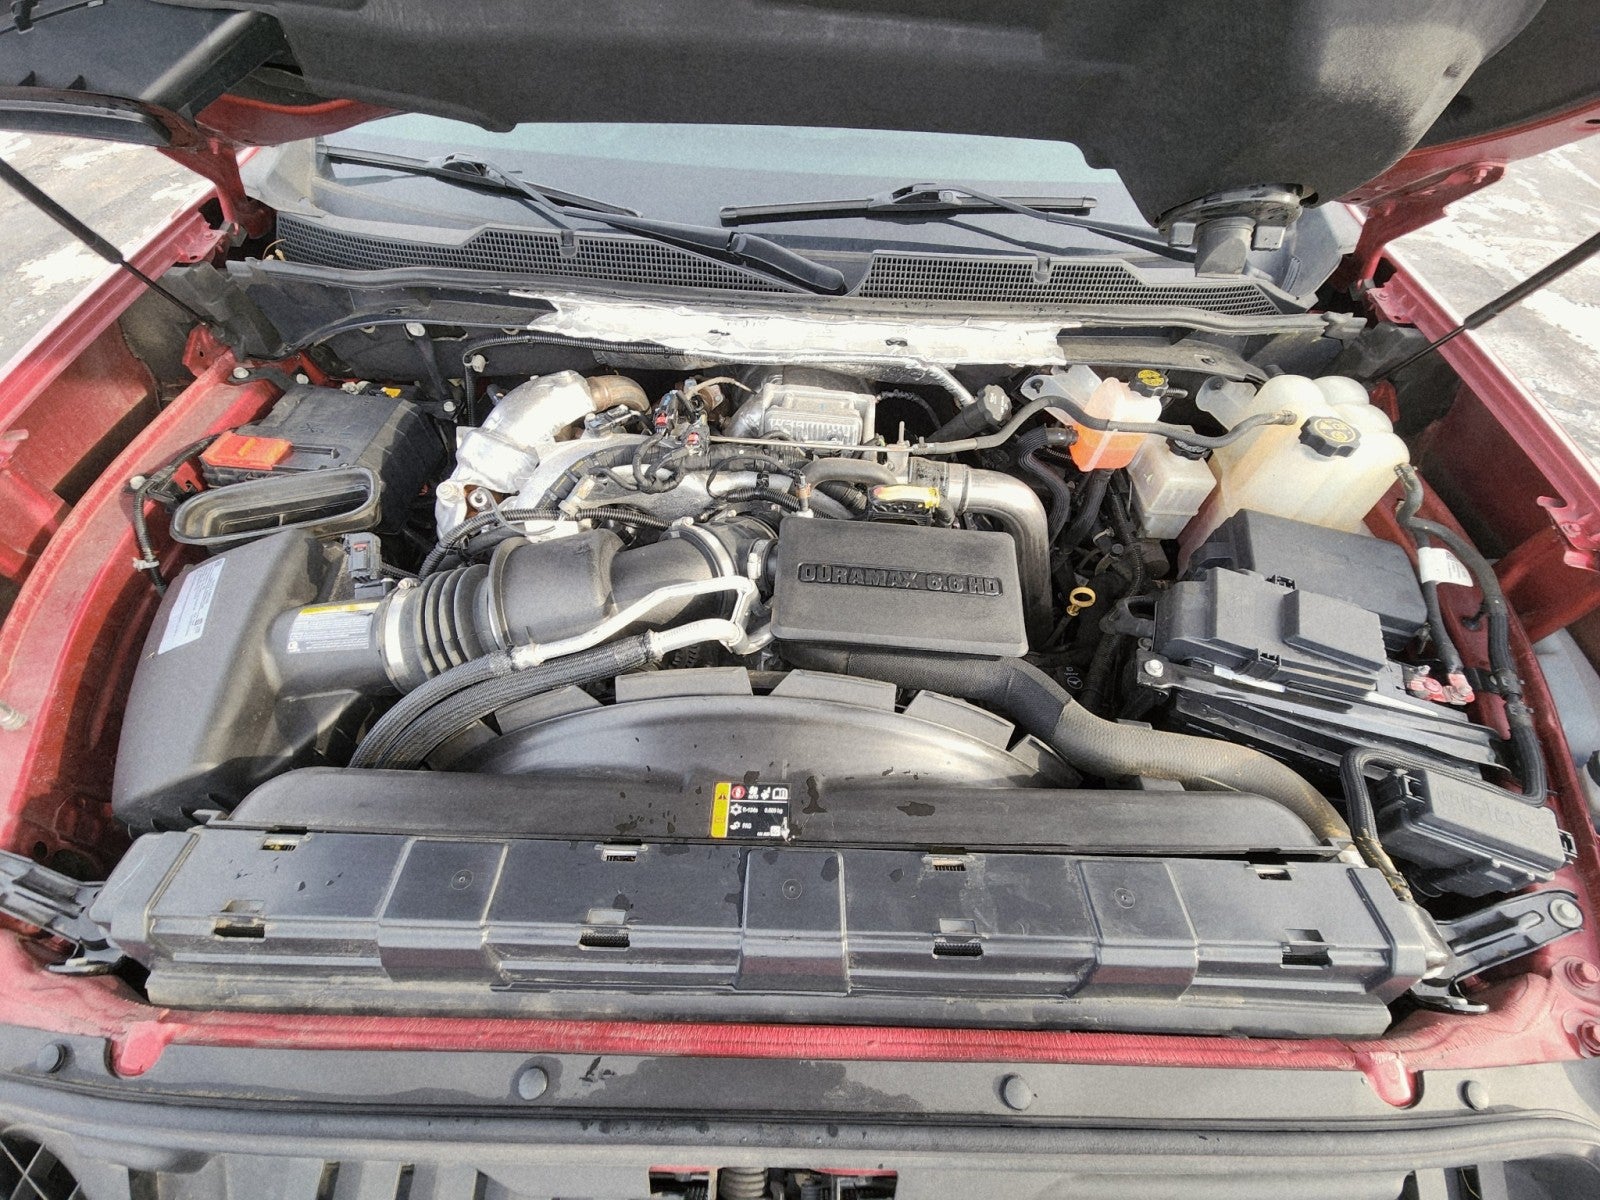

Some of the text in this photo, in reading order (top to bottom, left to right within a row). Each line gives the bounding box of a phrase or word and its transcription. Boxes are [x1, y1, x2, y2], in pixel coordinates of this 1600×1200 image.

[800, 564, 1000, 596] DURAMAX 6.6 HD
